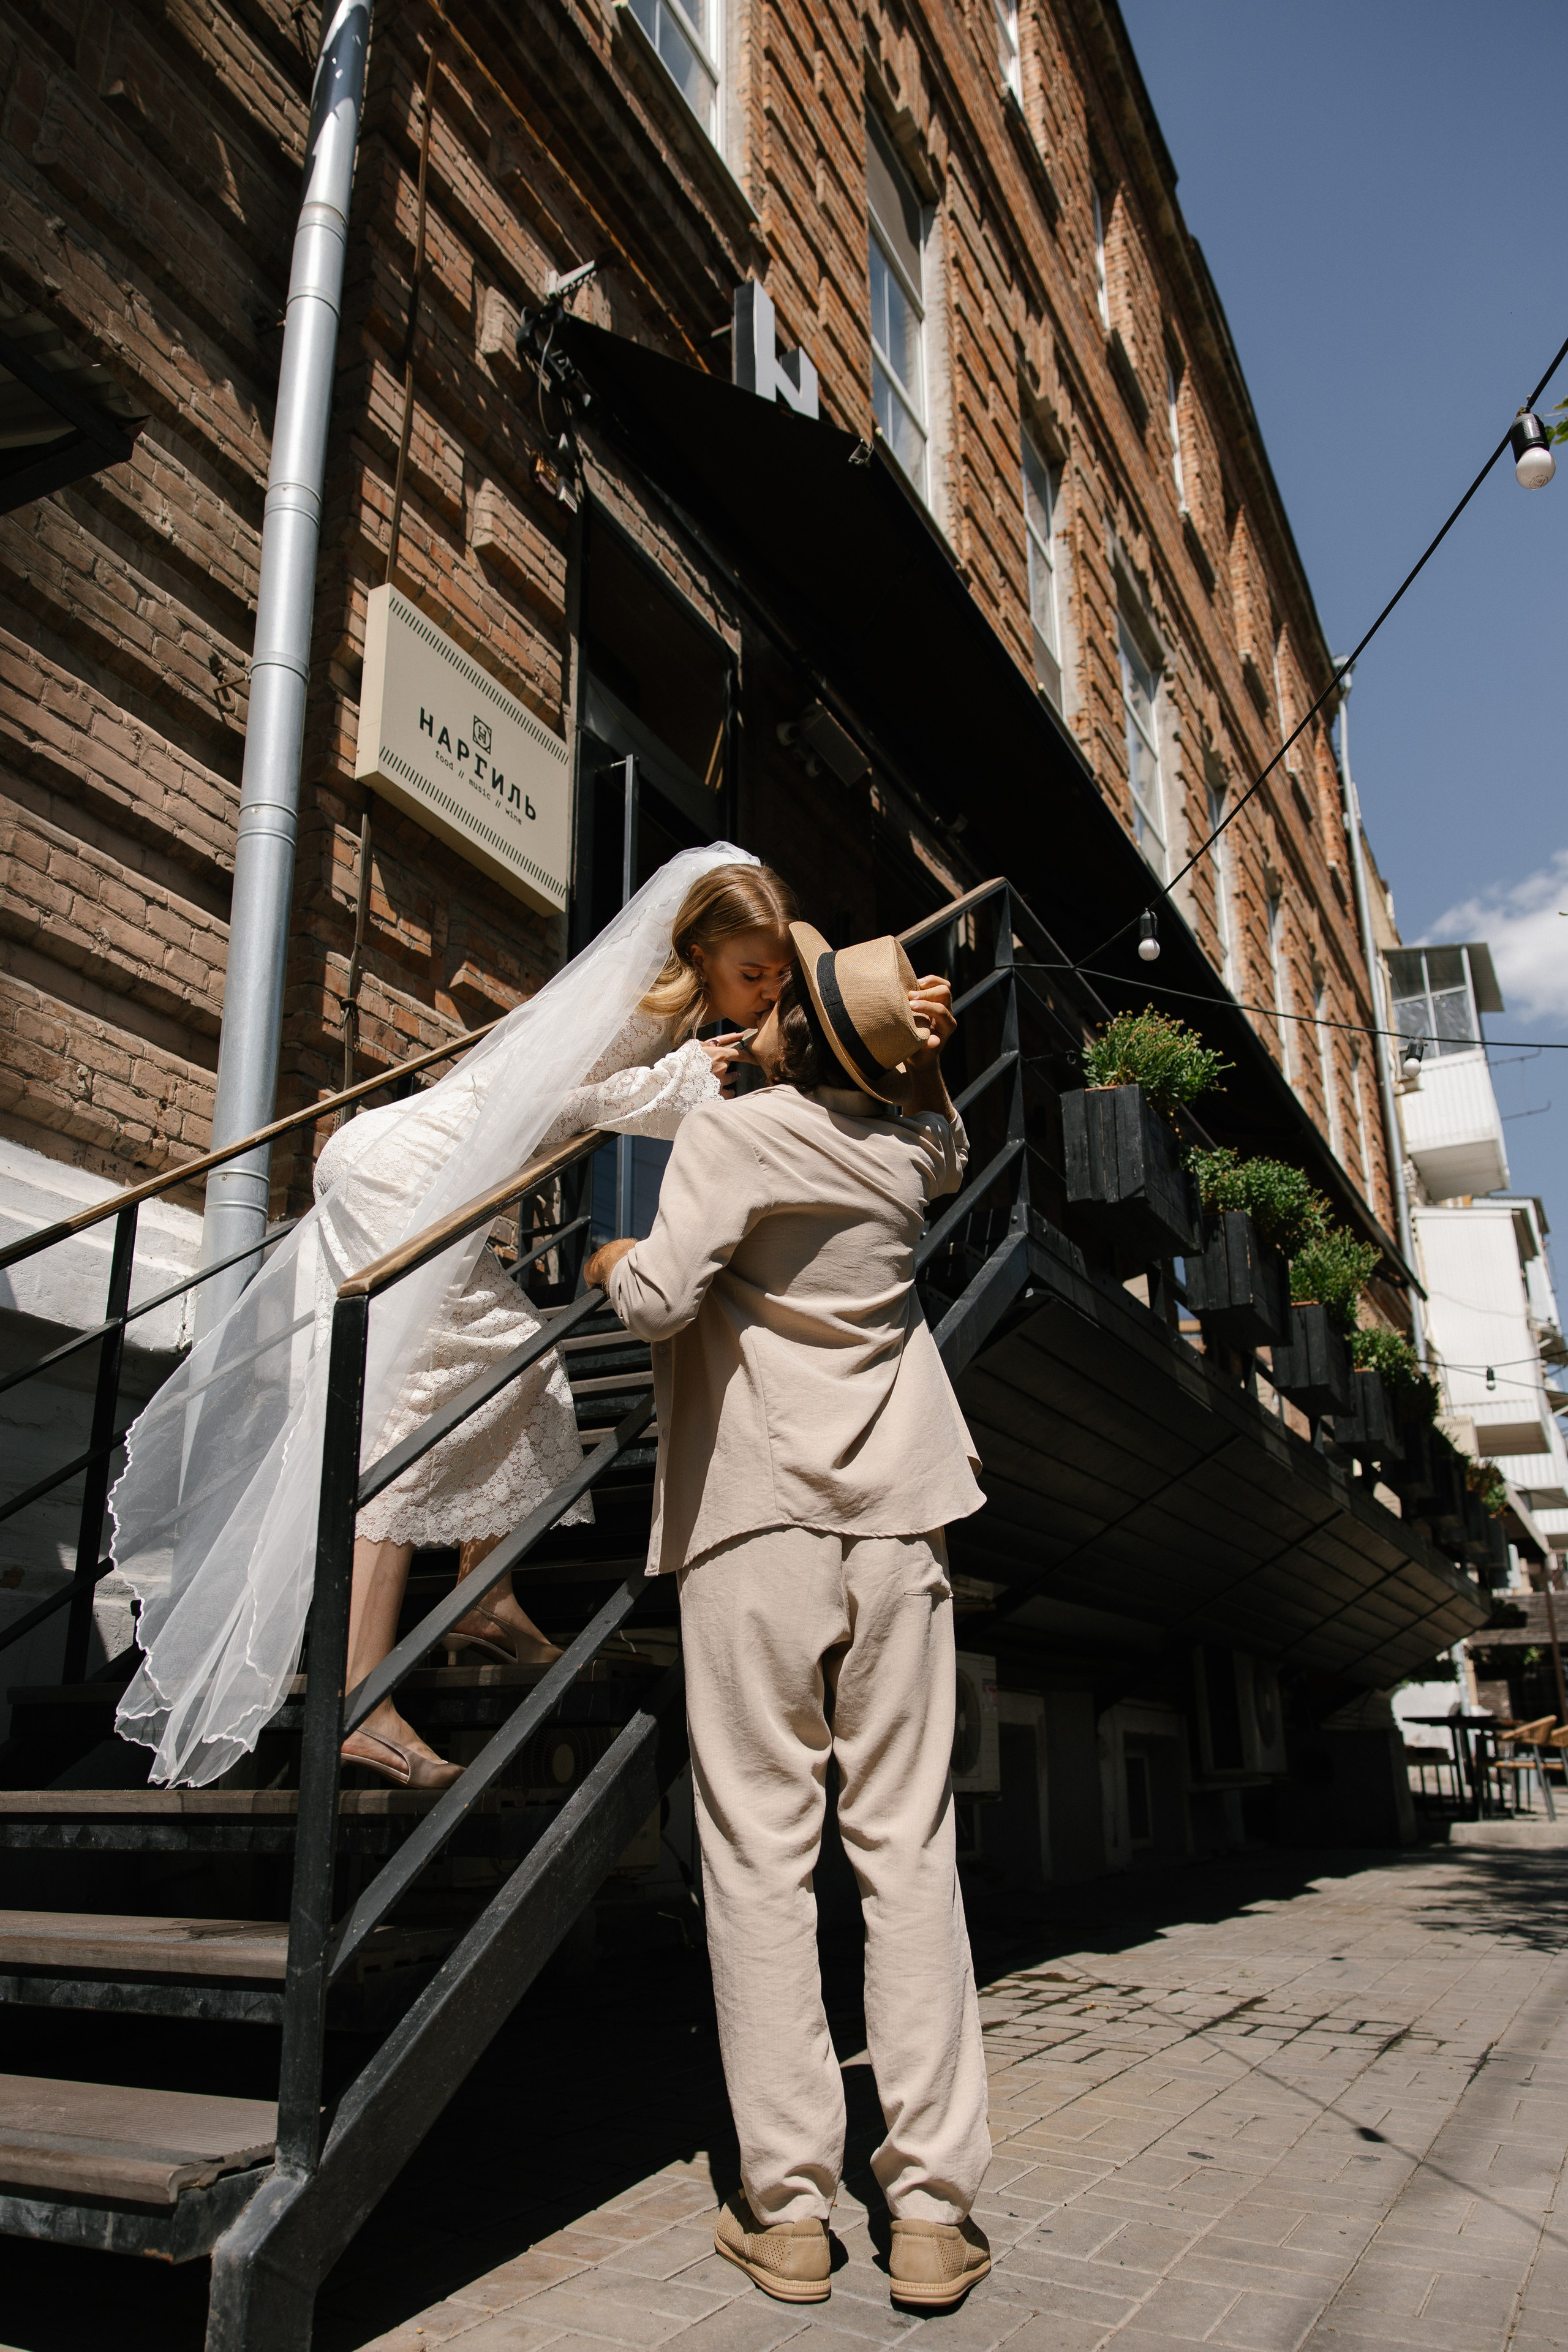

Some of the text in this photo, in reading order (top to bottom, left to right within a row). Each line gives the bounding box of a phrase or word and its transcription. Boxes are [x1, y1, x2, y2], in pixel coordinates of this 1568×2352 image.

[420, 706, 536, 821] НАРГИЛЬ
[435, 750, 453, 771] food
[469, 778, 491, 800] music
[505, 808, 522, 825] wine
